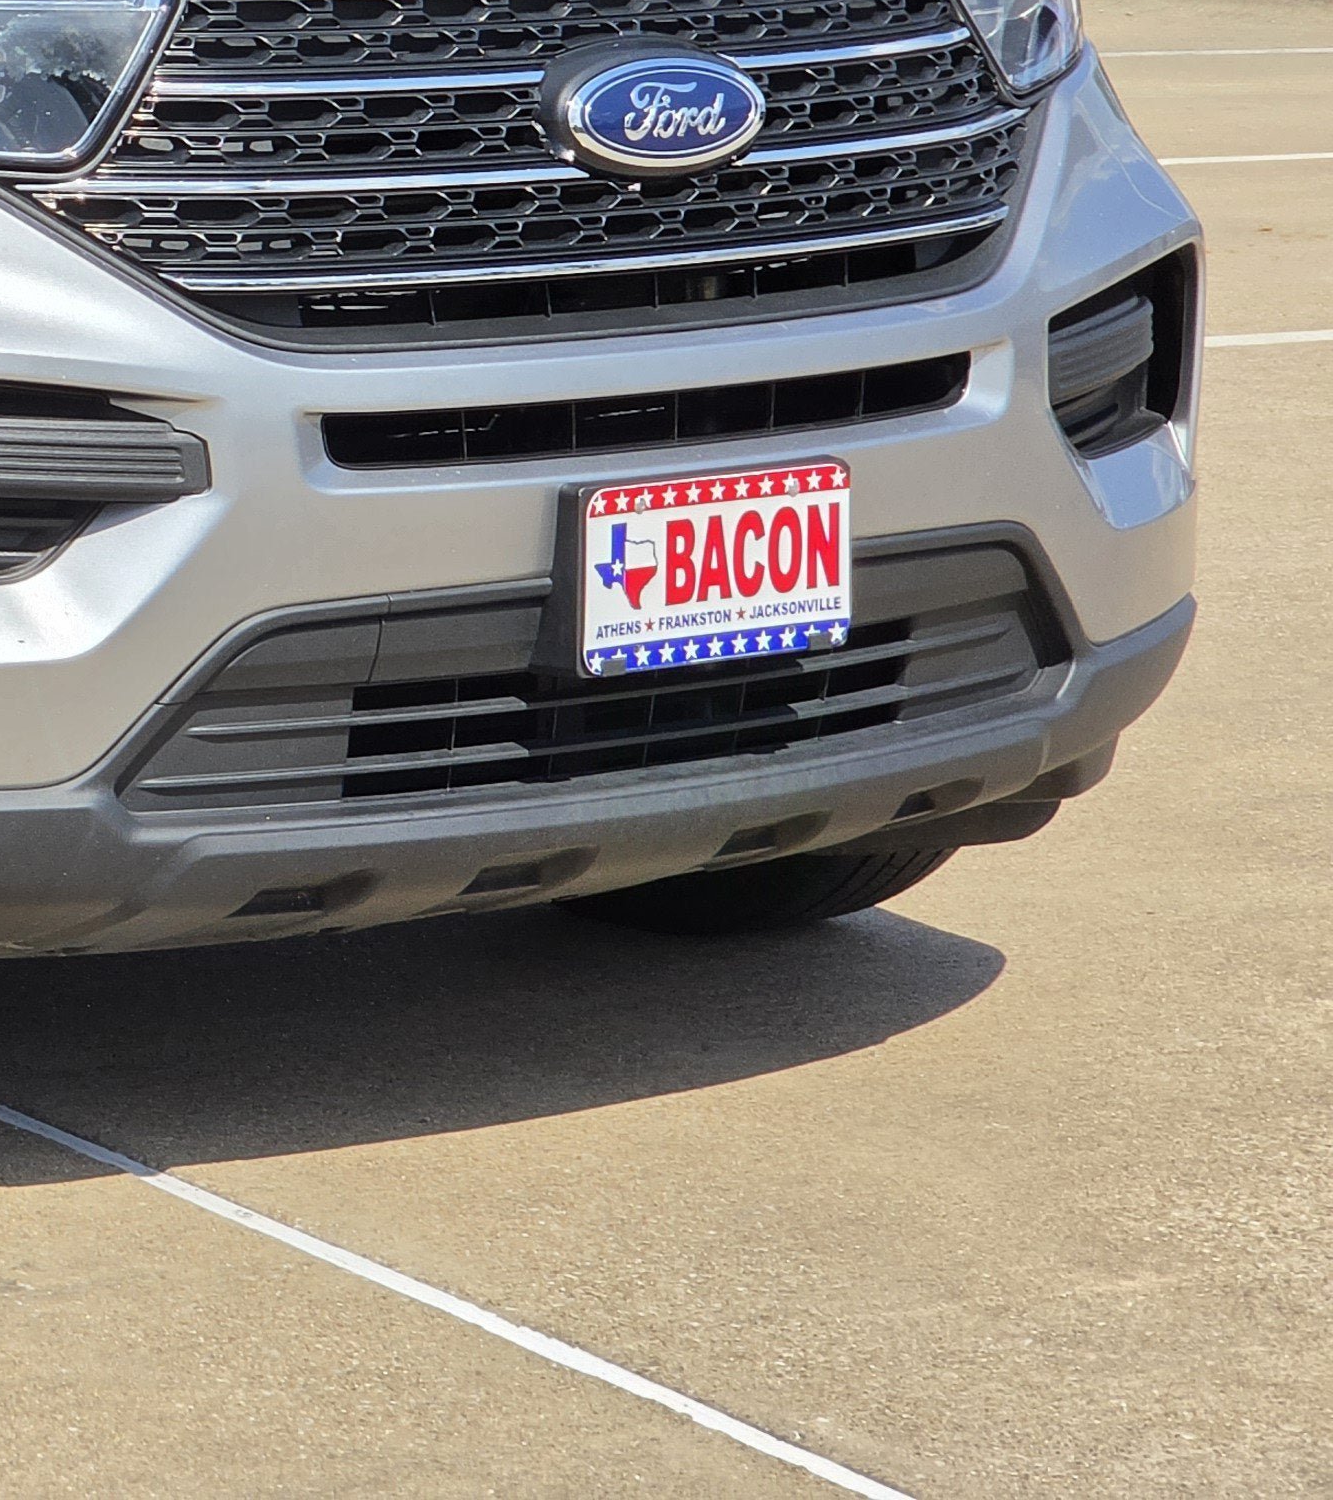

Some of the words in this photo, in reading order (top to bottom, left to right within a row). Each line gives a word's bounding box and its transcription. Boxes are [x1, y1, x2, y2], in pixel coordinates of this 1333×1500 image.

[623, 81, 727, 142] Ford
[664, 501, 840, 607] BACON
[596, 619, 642, 640] ATHENS
[658, 608, 732, 631] FRANKSTON
[749, 596, 842, 619] JACKSONVILLE
